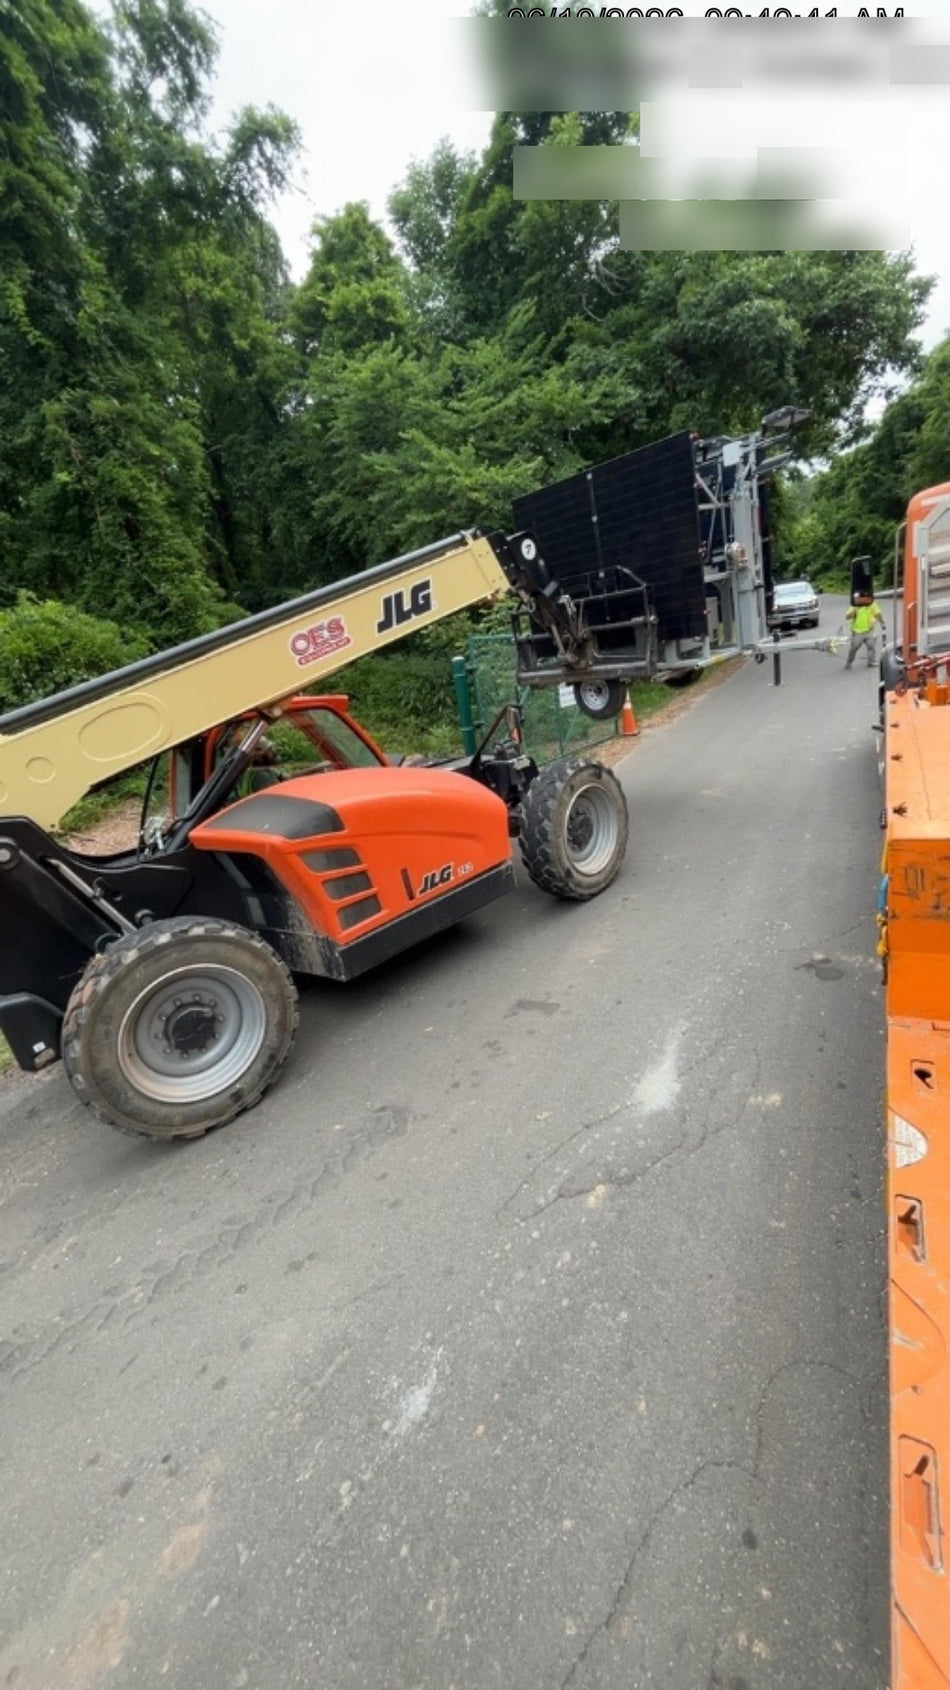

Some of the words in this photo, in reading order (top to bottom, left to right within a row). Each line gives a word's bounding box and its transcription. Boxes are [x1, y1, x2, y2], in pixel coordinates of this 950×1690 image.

[377, 579, 432, 633] JLG
[291, 617, 345, 655] OES
[418, 863, 453, 895] JLG
